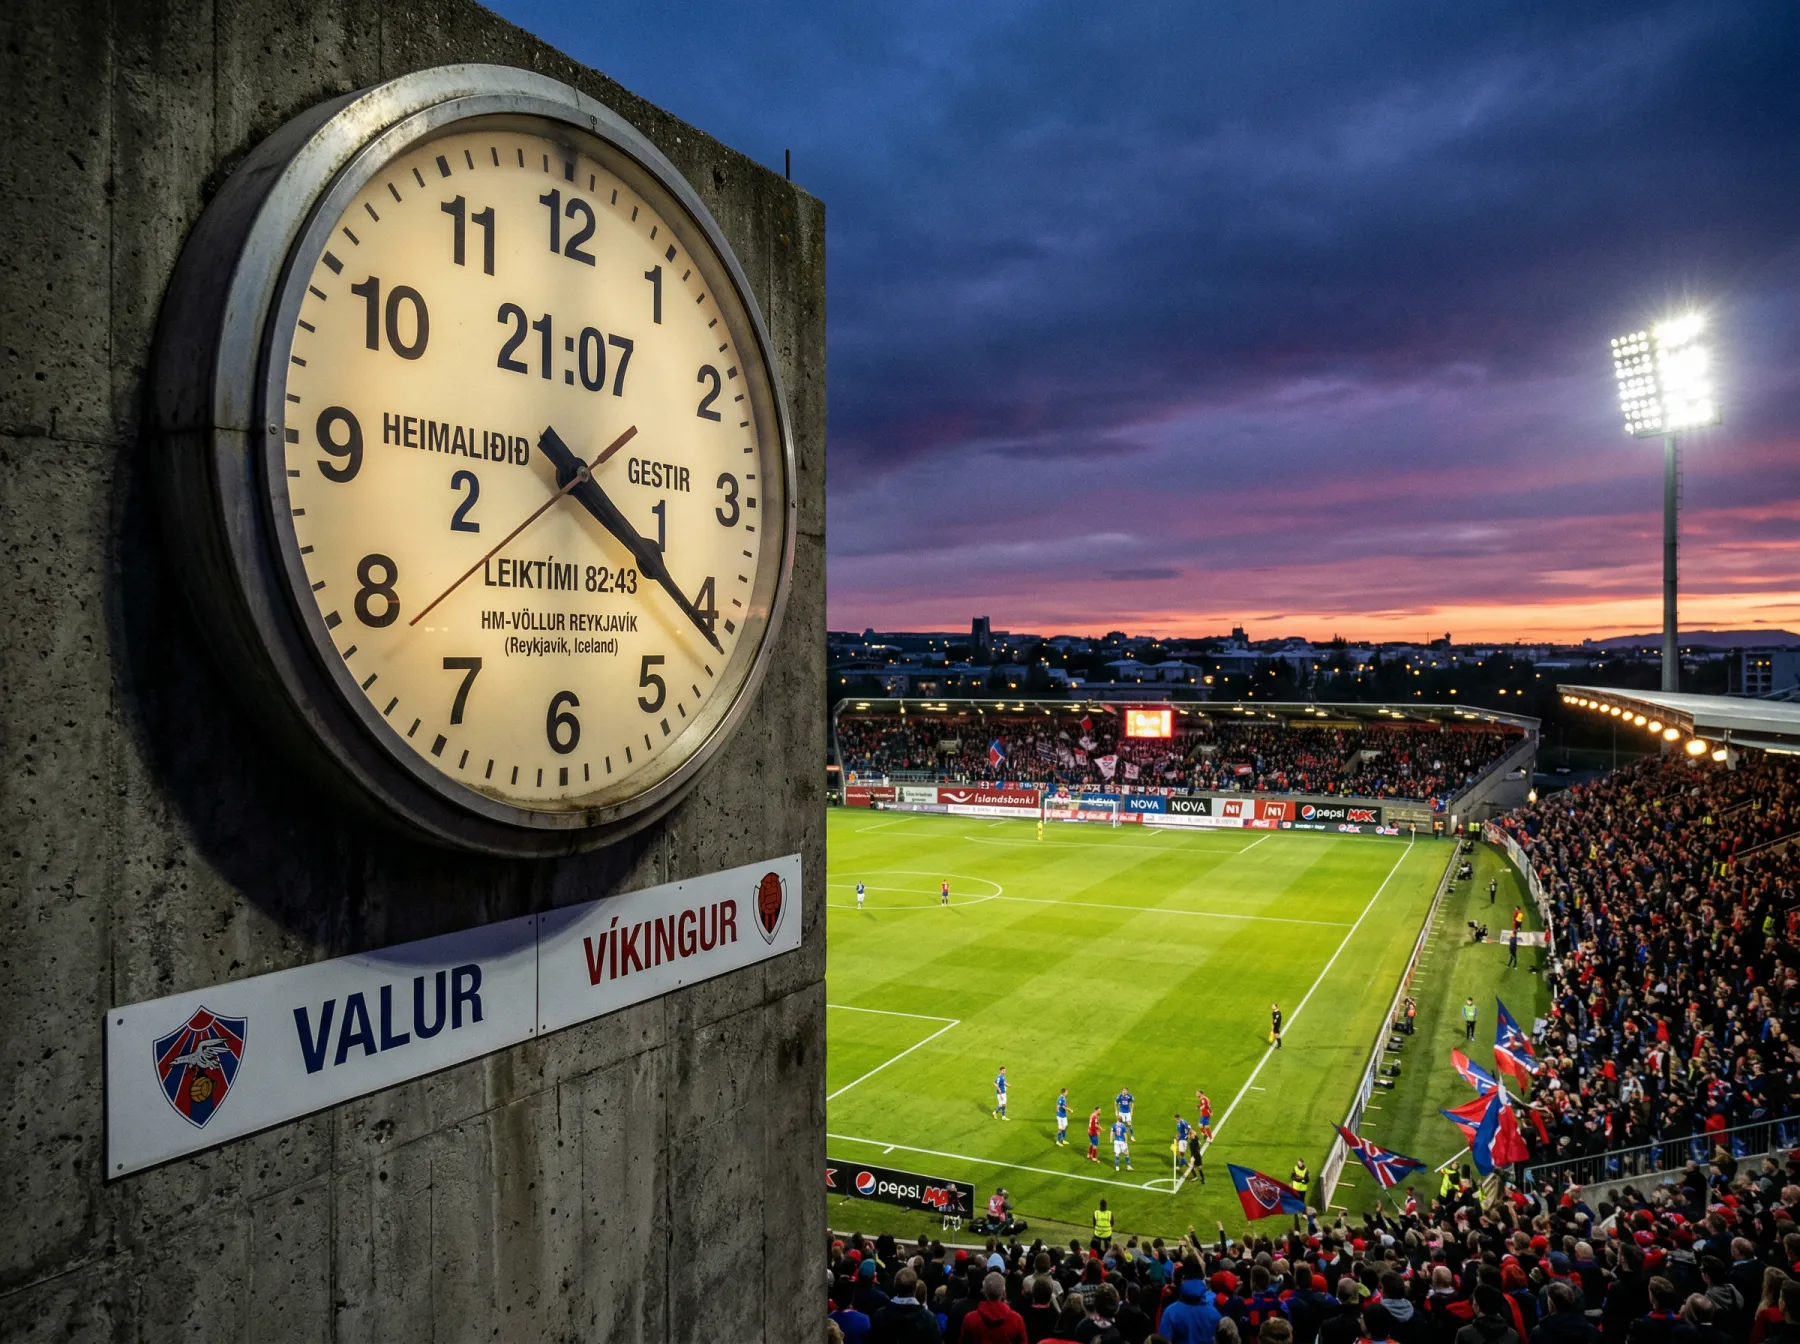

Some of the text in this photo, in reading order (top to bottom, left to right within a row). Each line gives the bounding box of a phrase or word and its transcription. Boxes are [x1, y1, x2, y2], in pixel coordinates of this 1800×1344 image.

[441, 195, 495, 276] 11
[539, 189, 596, 266] 12
[351, 276, 429, 360] 10
[645, 265, 662, 325] 1
[497, 303, 633, 397] 21:07
[696, 364, 722, 422] 2
[316, 406, 364, 483] 9
[383, 412, 530, 466] HEIMALIÐIÐ
[450, 470, 480, 533] 2
[628, 458, 691, 493] GESTIR
[715, 472, 741, 528] 3
[652, 499, 666, 552] 1
[354, 554, 400, 628] 8
[484, 556, 638, 595] LEIKTÍMI 82:43
[692, 576, 719, 631] 4
[481, 610, 638, 633] HM-VÖLLUR REYKJAVÍK
[504, 637, 619, 656] (Reykjavík, Iceland)
[443, 657, 482, 725] 7
[638, 655, 666, 713] 5
[546, 690, 581, 754] 6
[1130, 799, 1159, 810] NOVA
[1171, 801, 1206, 813] NOVA
[1225, 804, 1240, 814] N1
[1267, 806, 1281, 816] N1
[1316, 808, 1345, 819] pepsi
[1347, 808, 1377, 823] MAX
[583, 899, 739, 986] VÍKINGUR
[293, 964, 484, 1075] VALUR
[878, 1180, 920, 1199] pepsi
